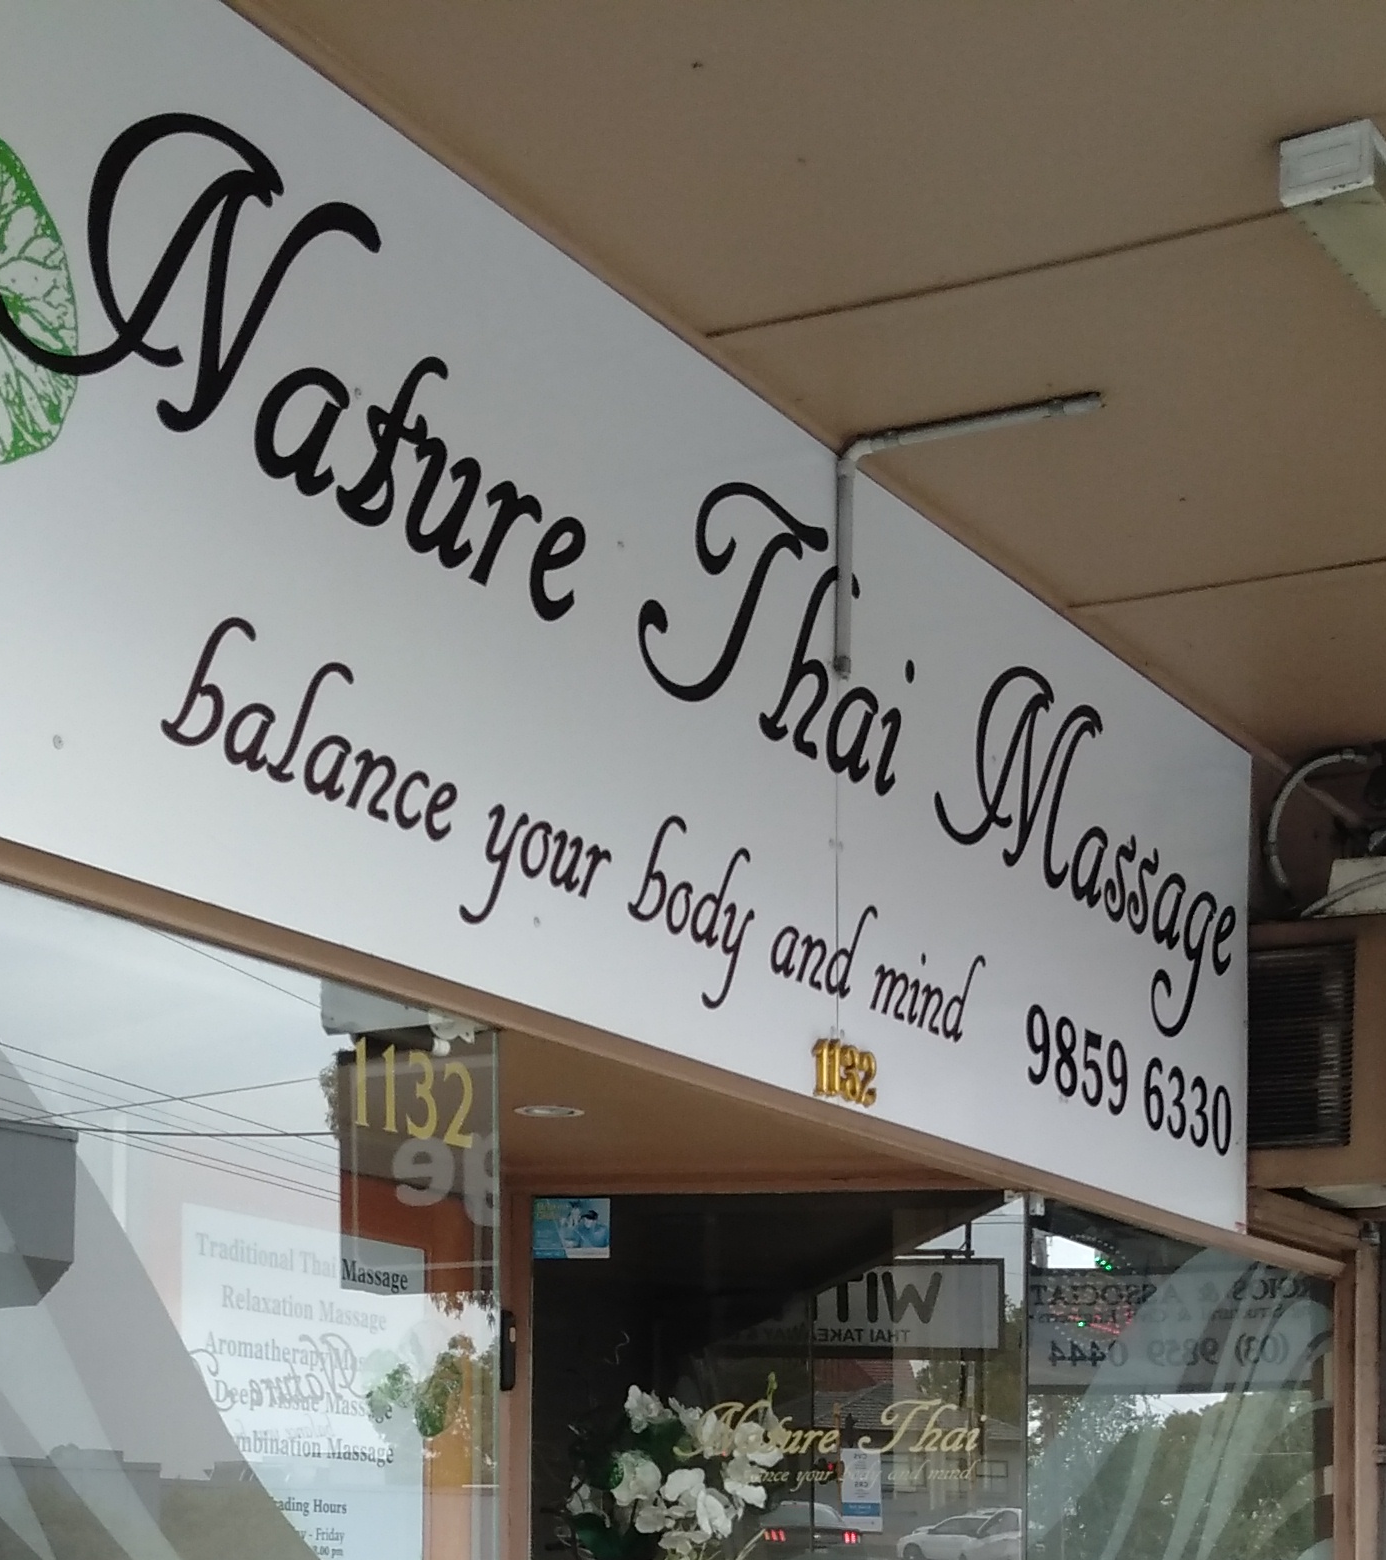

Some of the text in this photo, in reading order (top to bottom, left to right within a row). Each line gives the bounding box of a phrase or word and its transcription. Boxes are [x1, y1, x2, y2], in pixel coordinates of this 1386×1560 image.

[638, 481, 902, 797] Thai
[934, 665, 1237, 1038] Massage
[160, 616, 987, 1044] balance your body and mind
[355, 1036, 474, 1149] 1132
[813, 1038, 877, 1108] 1132
[1026, 1003, 1233, 1157] 9859 6330
[195, 1231, 409, 1294] Traditional Thai Massage
[221, 1285, 387, 1334] Relaxation Massage
[204, 1331, 330, 1373] Aromatherapy
[324, 1391, 393, 1424] Massge
[857, 1398, 988, 1455] Thai
[235, 1430, 394, 1468] mbination Massage
[313, 1499, 348, 1514] Hours
[315, 1528, 345, 1545] Friday
